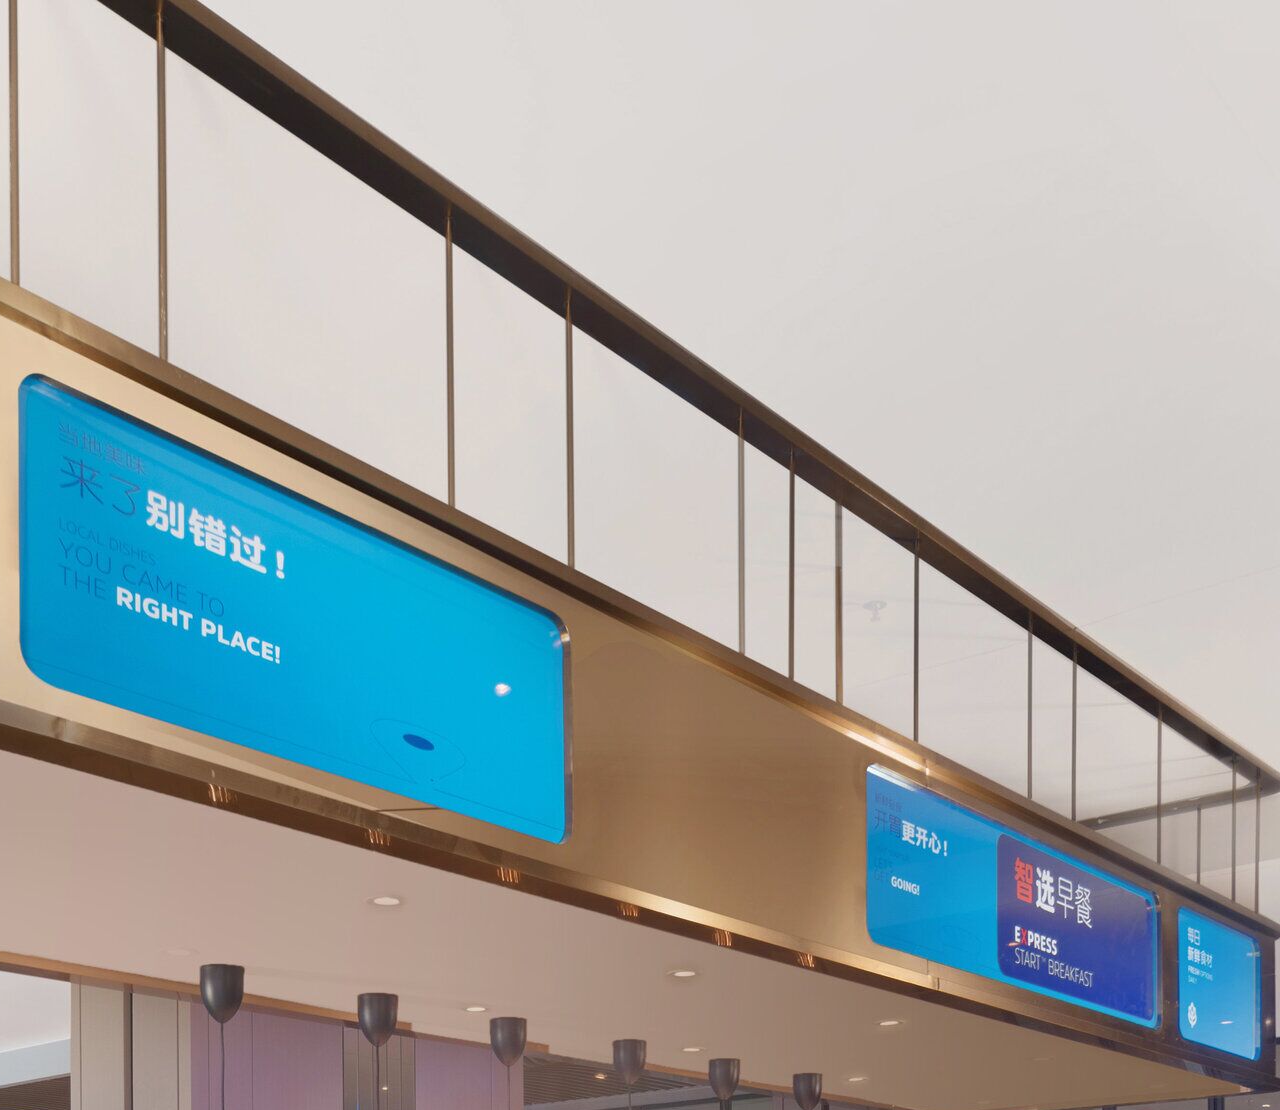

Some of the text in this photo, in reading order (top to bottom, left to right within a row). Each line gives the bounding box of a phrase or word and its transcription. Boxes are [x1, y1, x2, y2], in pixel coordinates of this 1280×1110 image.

[58, 422, 145, 476] 当地美味
[58, 517, 156, 566] LOCAL DISHES
[57, 536, 225, 618] YOU CAME TO
[58, 564, 281, 664] THE RIGHT PLACE!
[891, 876, 920, 896] GOING!
[1014, 857, 1093, 928] 智选早餐
[1014, 925, 1058, 956] EXPRESS
[1048, 959, 1093, 988] BREAKFAST
